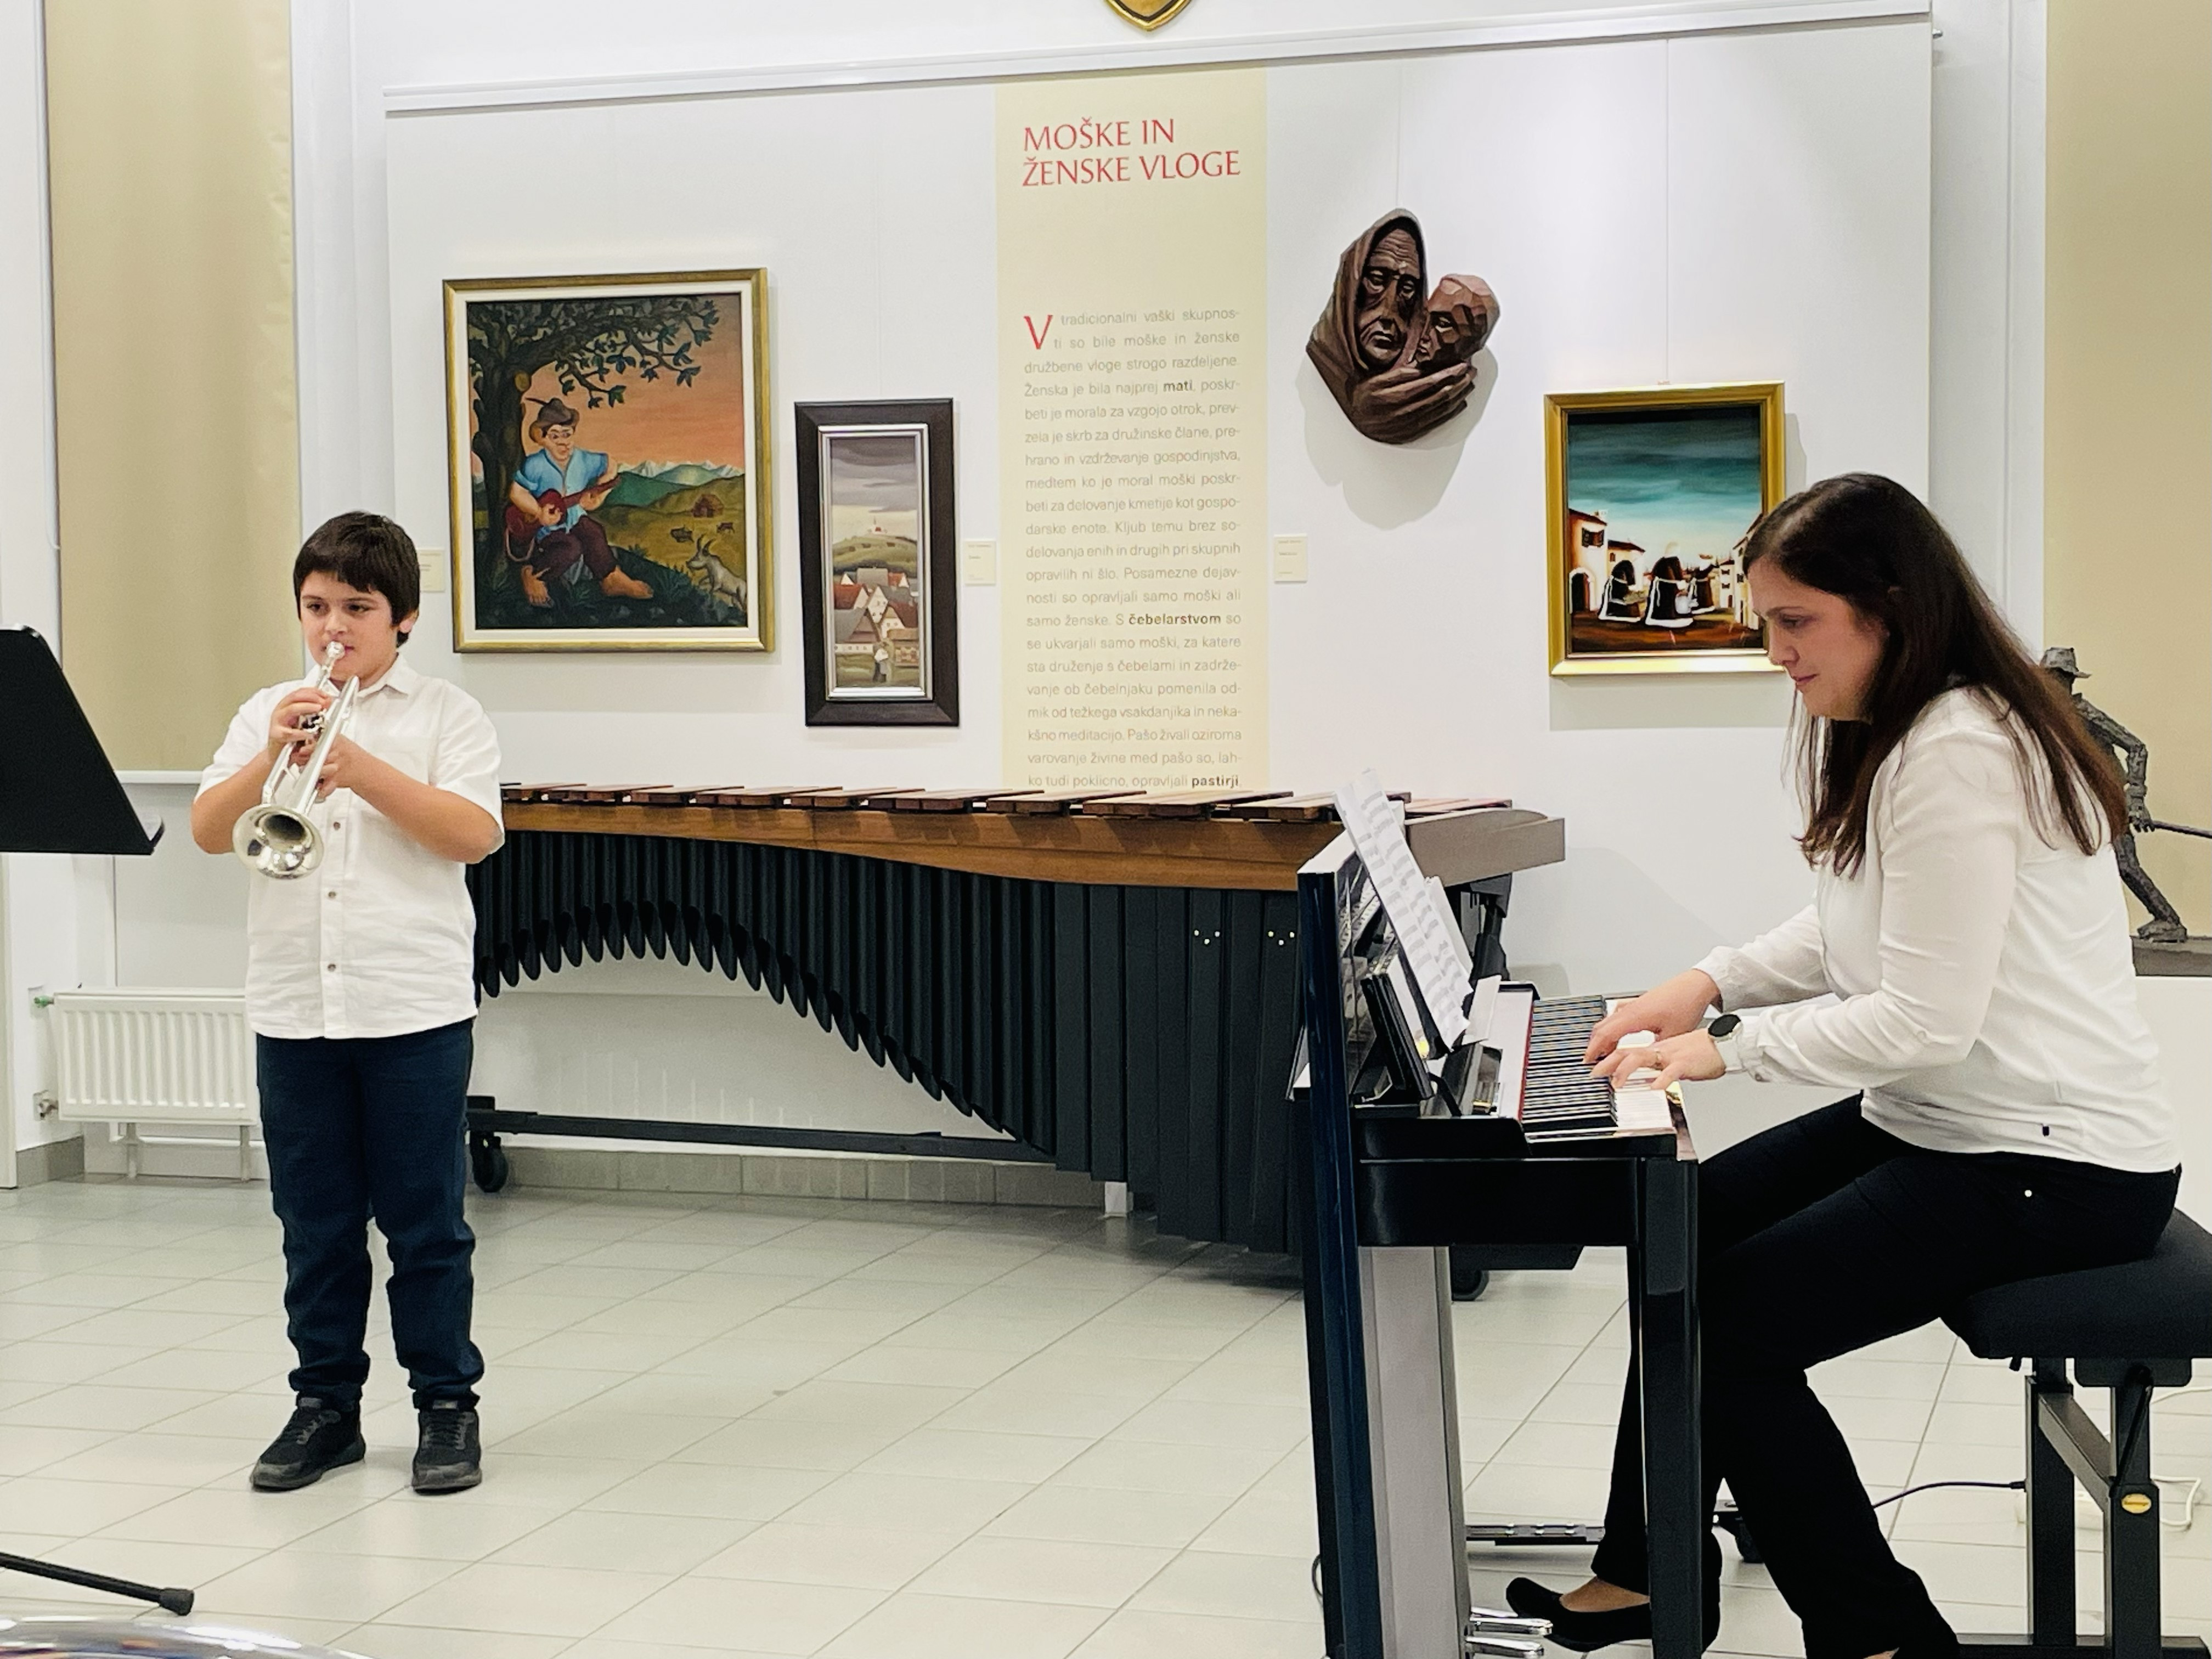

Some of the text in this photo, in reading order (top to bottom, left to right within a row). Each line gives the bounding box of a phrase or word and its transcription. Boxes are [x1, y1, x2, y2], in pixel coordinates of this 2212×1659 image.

[1024, 116, 1174, 151] MOŠKE IN
[1022, 150, 1241, 186] ŽENSKE VLOGE
[1023, 308, 1239, 349] V tradicionalni vaški skupnos-
[1054, 332, 1239, 349] ti so bile moške in ženske
[1024, 362, 1082, 374] družbene
[1088, 359, 1121, 373] vloge
[1127, 358, 1166, 371] strogo
[1024, 382, 1068, 397] Ženska
[1073, 385, 1084, 397] je
[1089, 383, 1110, 394] bila
[1116, 382, 1158, 396] najprej
[1201, 379, 1240, 393] poskr-
[1025, 408, 1047, 419] beti
[1051, 408, 1062, 421] je
[1065, 407, 1106, 418] morala
[1110, 408, 1124, 417] za
[1128, 406, 1167, 419] vzgojo
[1209, 404, 1239, 415] prev-
[1025, 432, 1049, 443] zela
[1052, 431, 1063, 444] je
[1066, 430, 1092, 441] skrb
[1095, 431, 1108, 440] za
[1112, 428, 1171, 441] družinske
[1215, 428, 1240, 439] pre-
[1025, 454, 1059, 466] hrano
[1064, 455, 1074, 465] in
[1080, 452, 1148, 466] vzdrževanje
[1026, 473, 1240, 490] medtem ko je moral moški poskr-
[1026, 496, 1240, 512] beti za delovanje kmetije kot gospo-
[1026, 523, 1066, 535] darske
[1115, 521, 1146, 535] Kljub
[1152, 522, 1182, 532] temu
[1189, 520, 1215, 531] brez
[1221, 520, 1240, 531] so-
[1026, 542, 1240, 559] delovanja enih in drugih pri skupnih
[1026, 569, 1076, 582] opravilih
[1082, 569, 1092, 579] ni
[1124, 567, 1197, 579] Posamezne
[1203, 566, 1241, 580] dejav-
[1026, 589, 1240, 605] nosti so opravljali samo moški ali
[1026, 618, 1060, 627] samo
[1115, 613, 1124, 625] S
[1128, 613, 1221, 625] čebelarstvom
[1226, 614, 1241, 624] so
[1027, 640, 1041, 650] se
[1046, 637, 1096, 651] ukvarjali
[1101, 639, 1135, 648] samo
[1184, 638, 1198, 648] za
[1203, 636, 1241, 648] katere
[1027, 658, 1242, 674] sta druženje s čebelami in zadrže-
[1027, 682, 1242, 697] vanje ob čebelnjaku pomenila od-
[1028, 705, 1242, 720] mik od težkega vsakdanjika in neka-
[1028, 729, 1056, 741] kšno
[1128, 729, 1157, 740] Pašo
[1160, 729, 1189, 740] živali
[1192, 729, 1242, 740] oziroma
[1028, 753, 1086, 766] varovanje
[1091, 752, 1126, 764] živine
[1130, 753, 1158, 763] med
[1162, 752, 1193, 764] pašo
[1219, 752, 1242, 763] lah-
[1029, 775, 1042, 786] ko
[1046, 775, 1069, 786] tudi
[1132, 775, 1188, 788] opravljali
